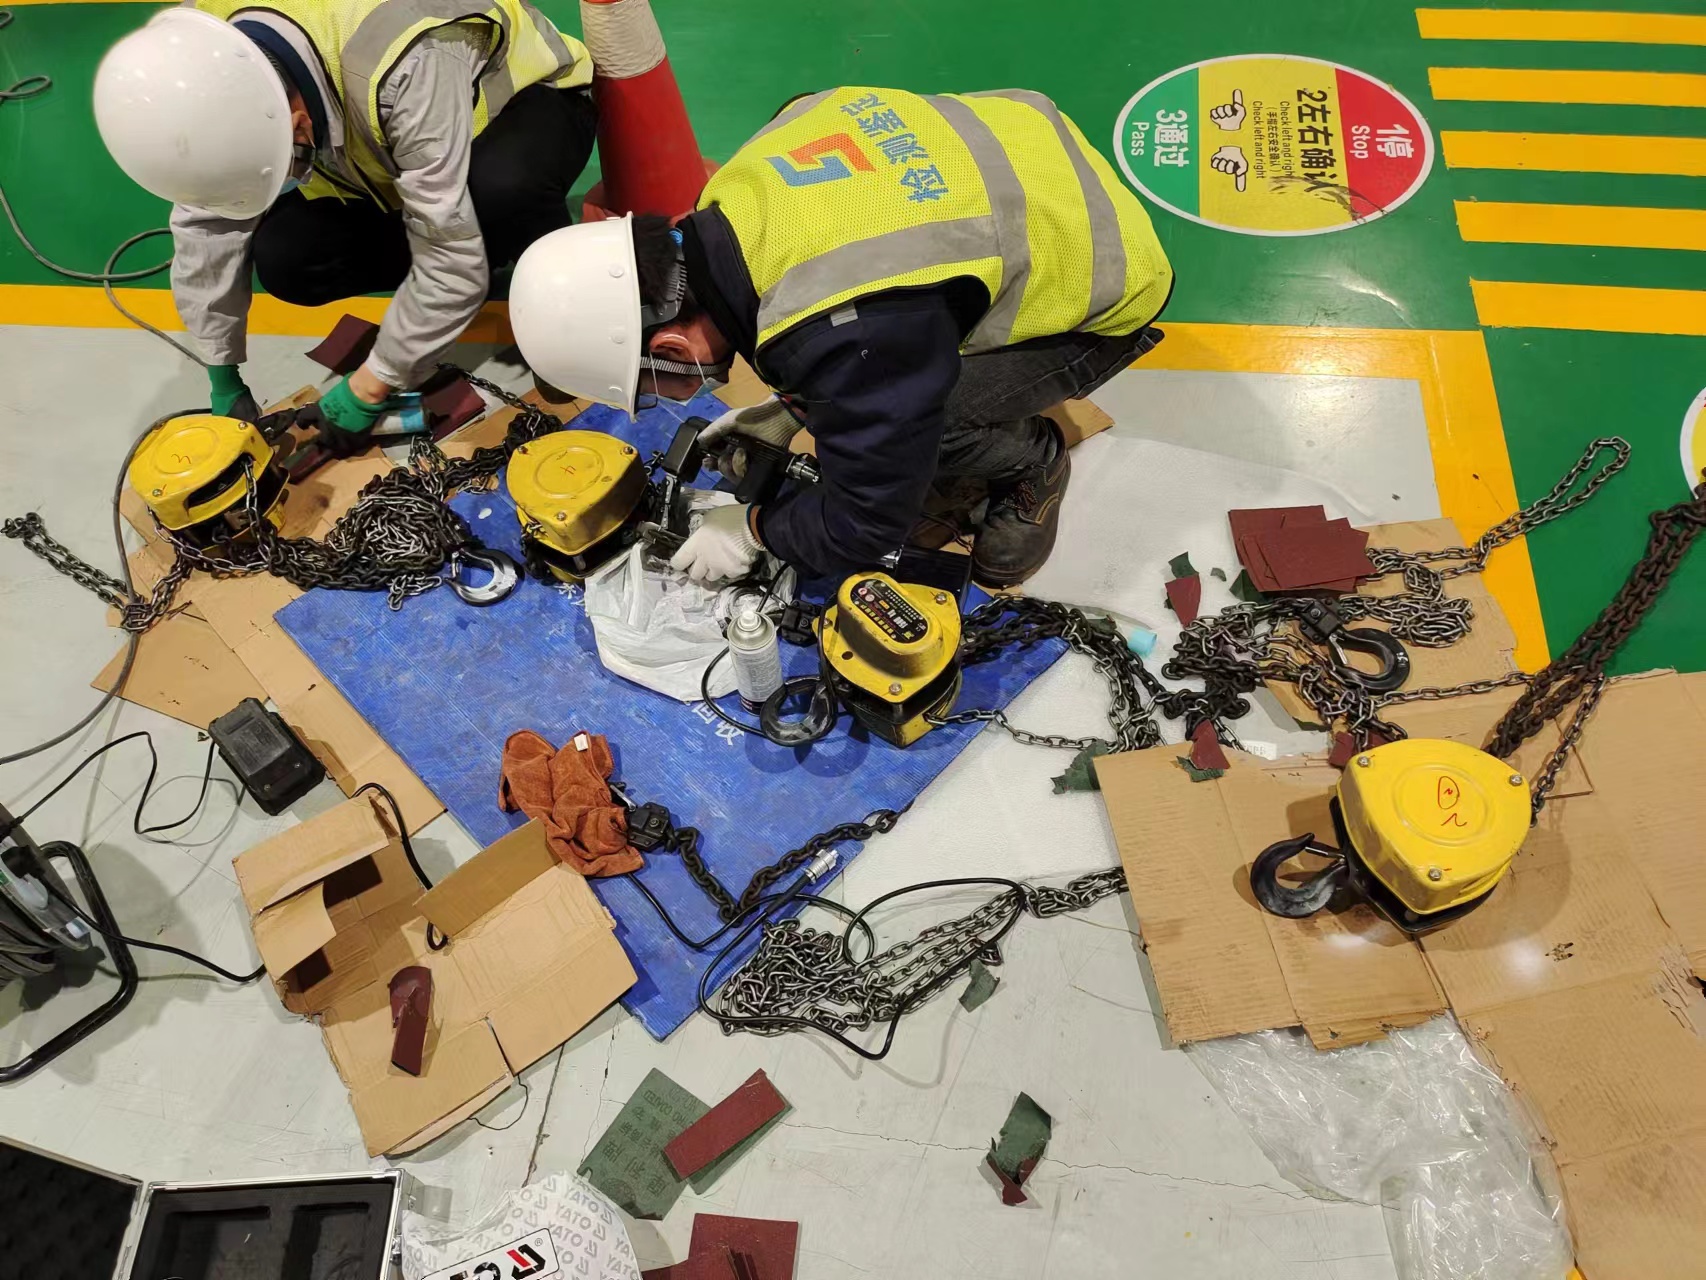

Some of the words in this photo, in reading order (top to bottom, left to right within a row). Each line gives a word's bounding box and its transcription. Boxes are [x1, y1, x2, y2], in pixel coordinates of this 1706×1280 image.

[1253, 100, 1264, 126] Check
[1280, 101, 1292, 126] Check
[1130, 122, 1150, 156] Pass
[1154, 109, 1189, 167] 3通过
[1254, 127, 1265, 140] left
[1282, 127, 1293, 141] left
[1297, 89, 1338, 192] 2左右确认
[1349, 125, 1371, 159] Stop
[1375, 124, 1414, 158] 1停
[840, 92, 949, 203] 检测鉴定
[1255, 142, 1266, 157] and
[1282, 142, 1294, 158] and
[1253, 158, 1266, 179] right
[1282, 159, 1295, 176] righ
[564, 1187, 598, 1213] YATO
[555, 1203, 591, 1229] YATO
